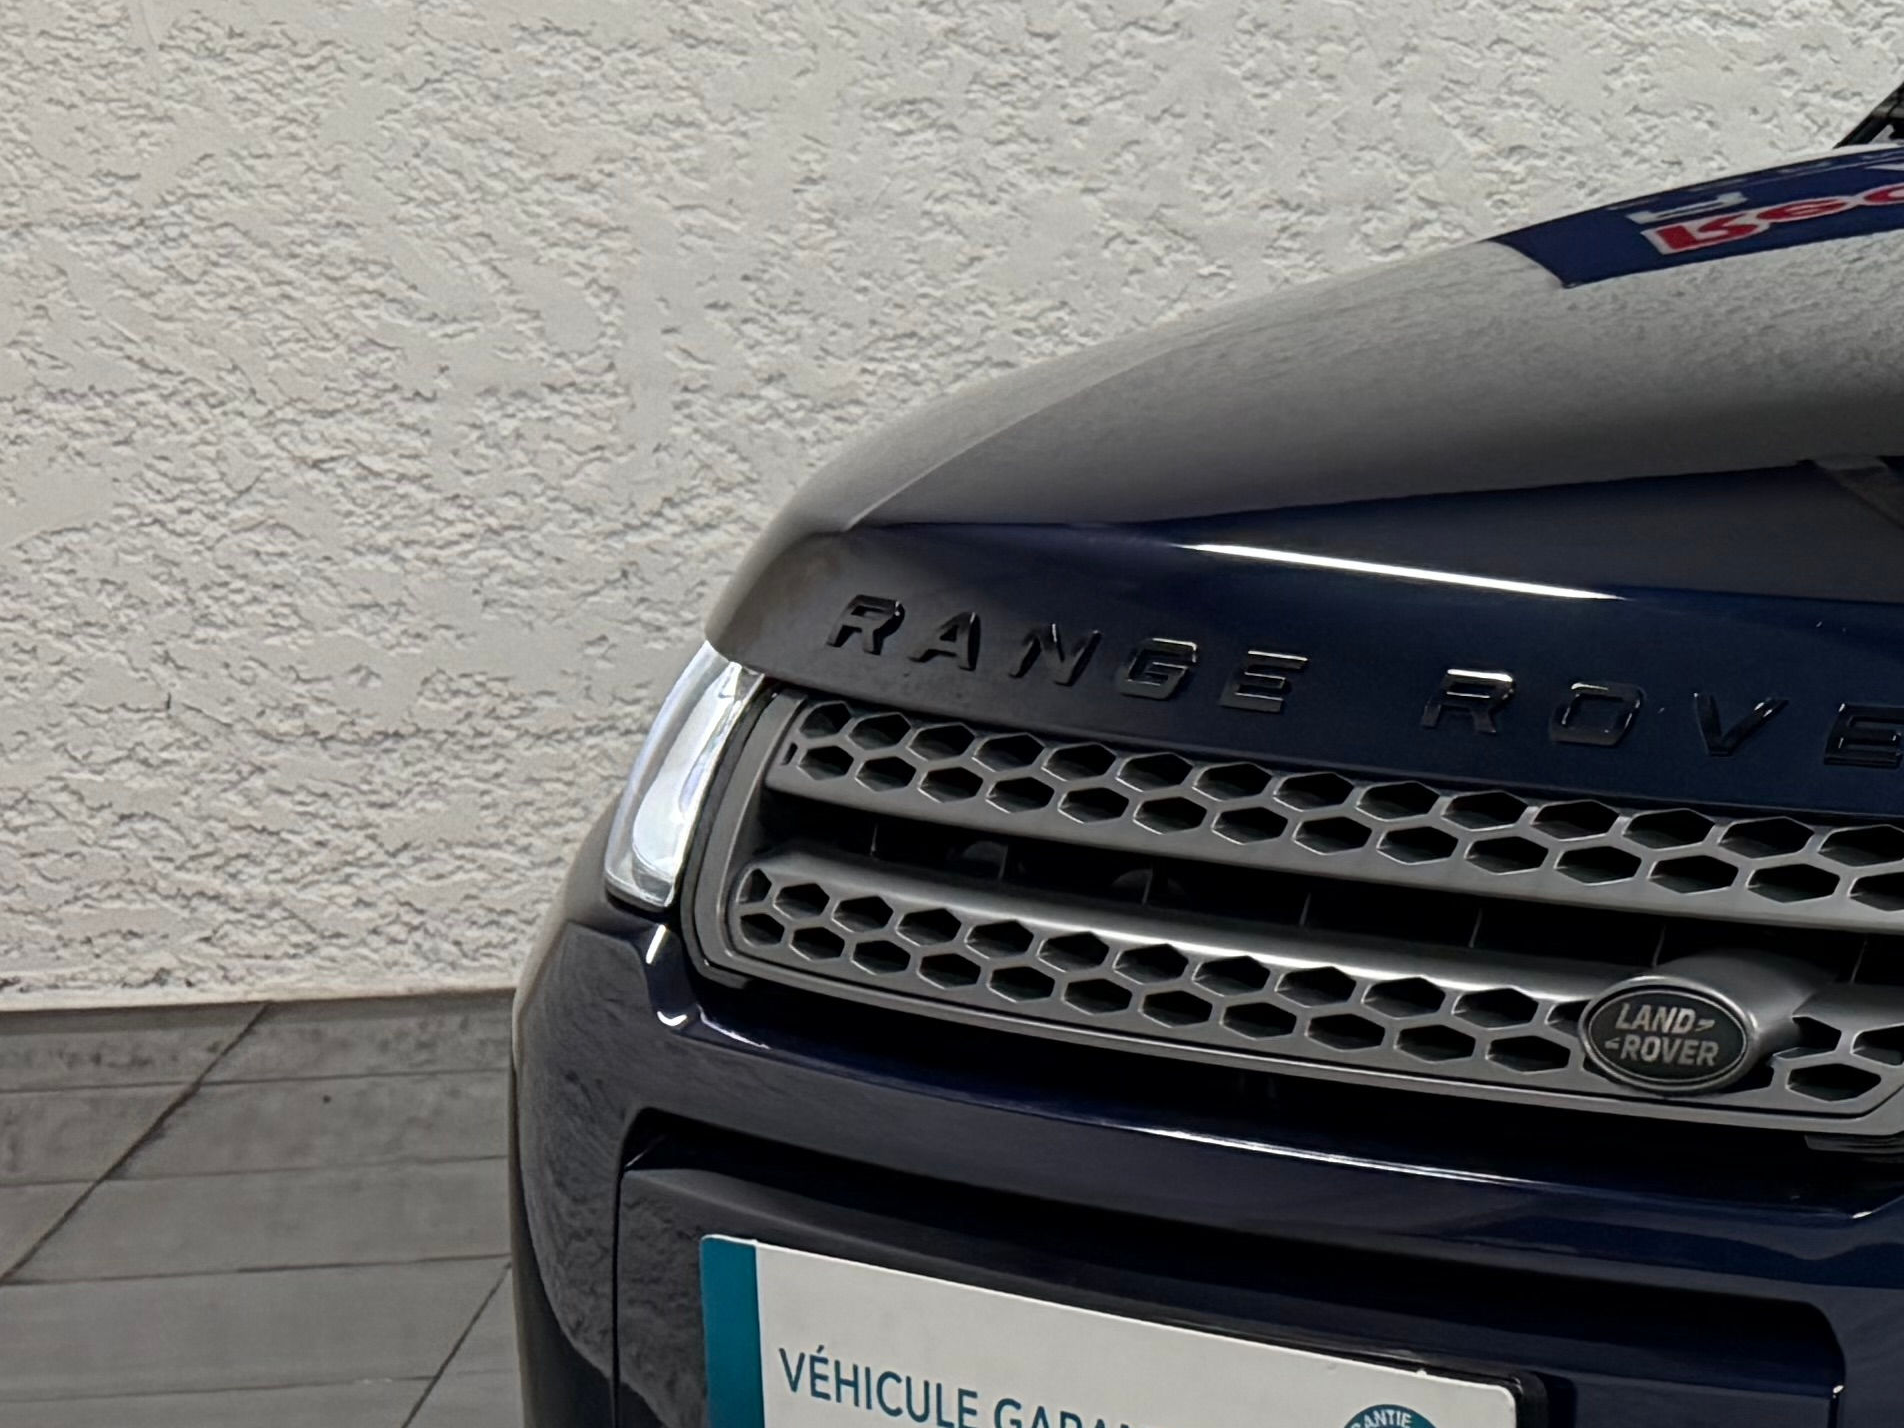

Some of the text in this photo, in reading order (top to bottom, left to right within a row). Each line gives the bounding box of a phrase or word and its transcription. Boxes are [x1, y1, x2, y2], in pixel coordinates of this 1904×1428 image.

[826, 593, 1308, 713] RANGE
[1615, 1002, 1697, 1034] LAND
[1619, 1033, 1719, 1066] ROVER
